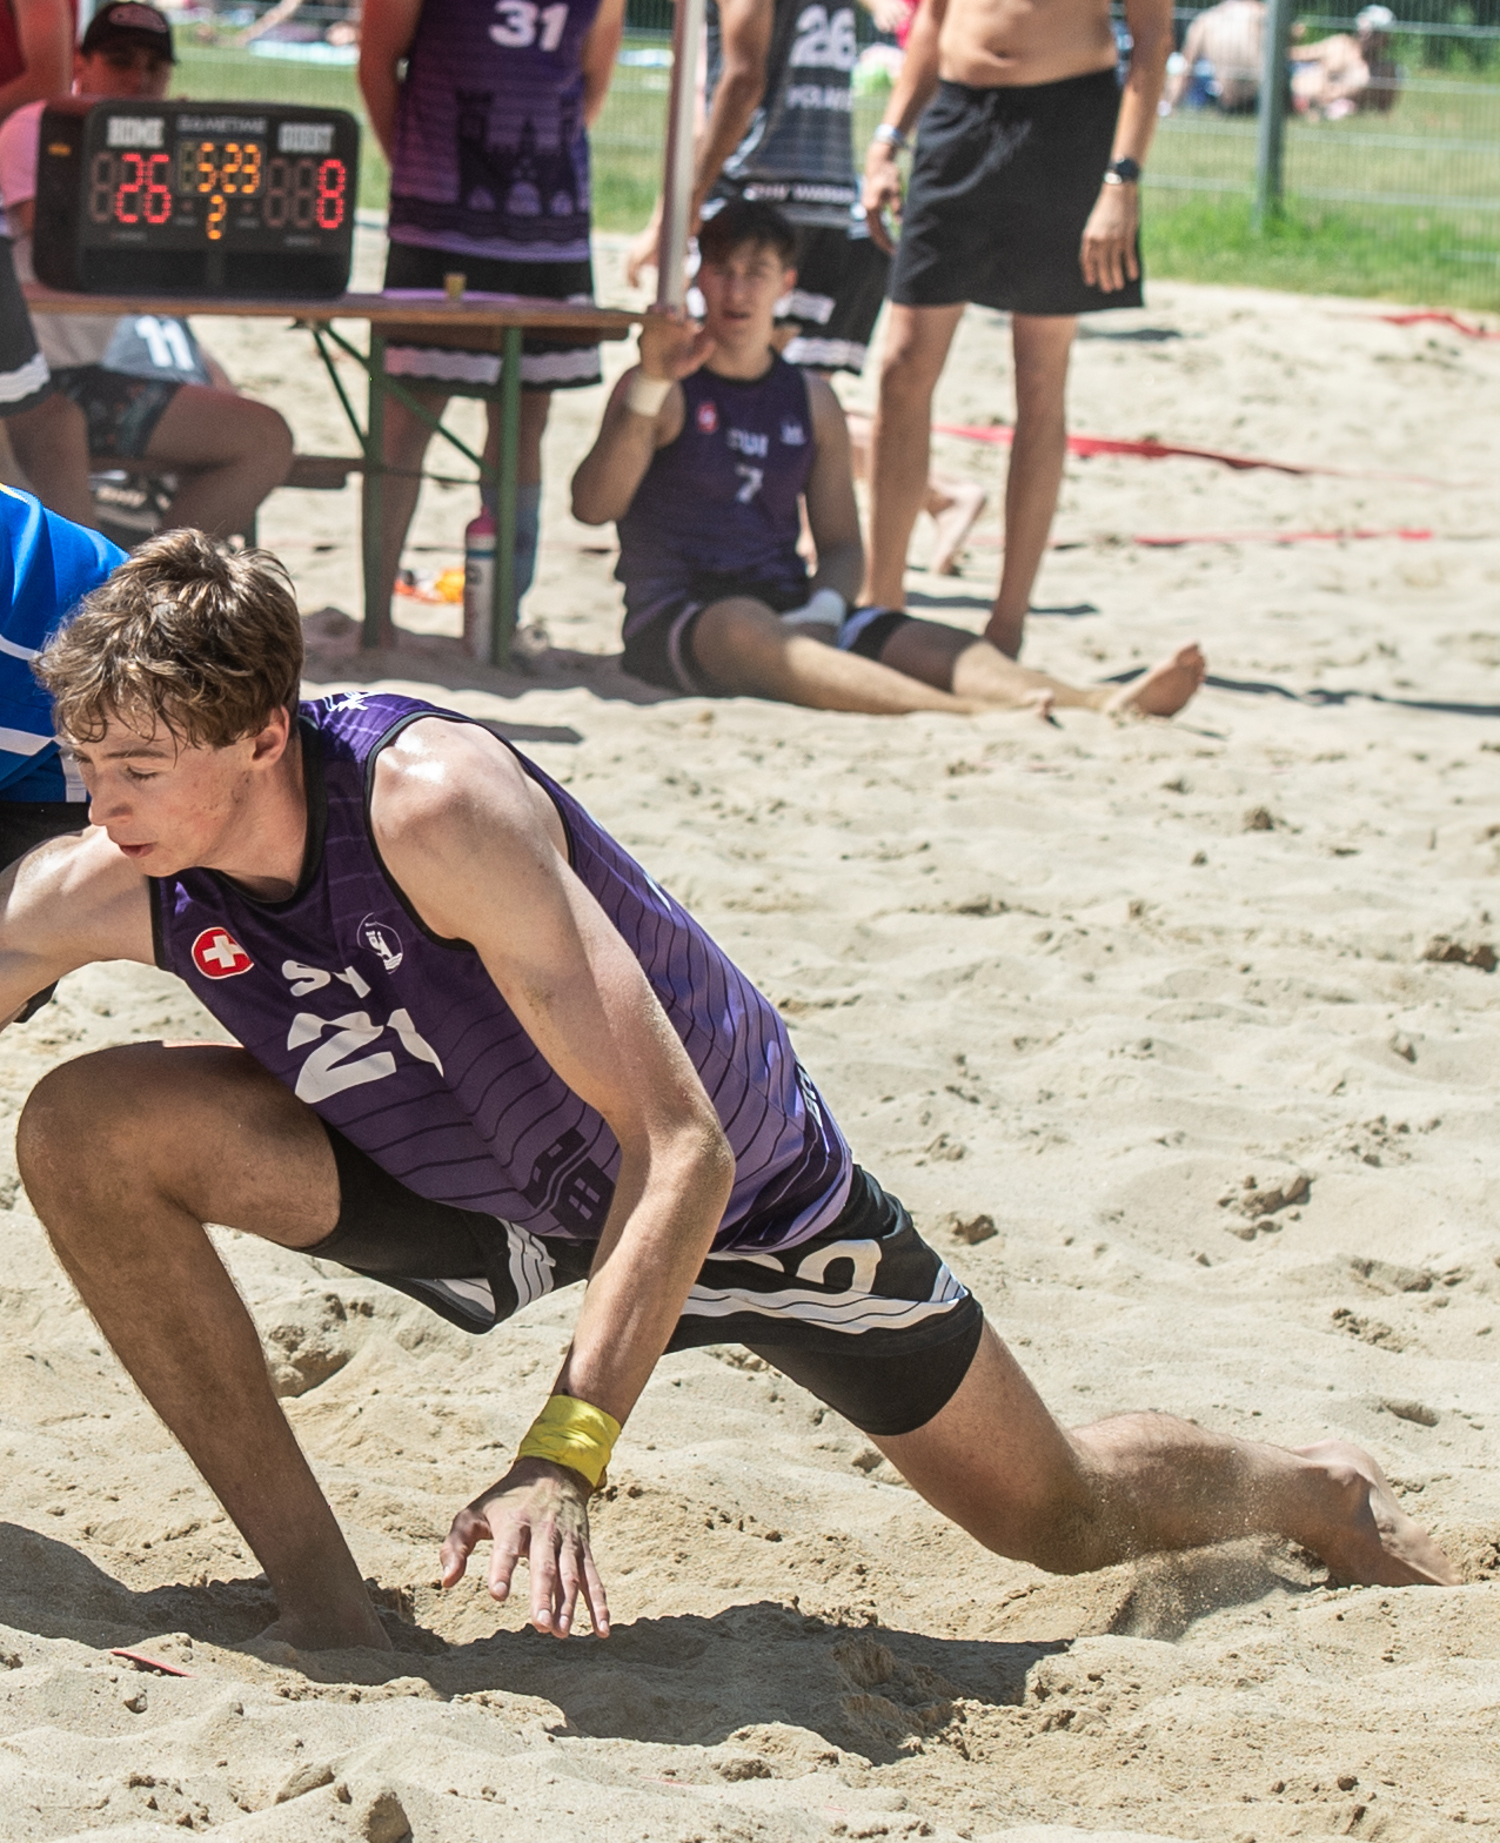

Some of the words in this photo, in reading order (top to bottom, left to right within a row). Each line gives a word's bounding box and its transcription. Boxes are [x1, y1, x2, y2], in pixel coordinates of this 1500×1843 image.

[488, 0, 569, 51] 31
[789, 4, 856, 70] 26
[115, 153, 172, 224] 26
[316, 159, 346, 229] 8
[206, 194, 227, 240] 2
[134, 315, 195, 371] 11
[735, 463, 763, 503] 7
[287, 1008, 445, 1105] 21
